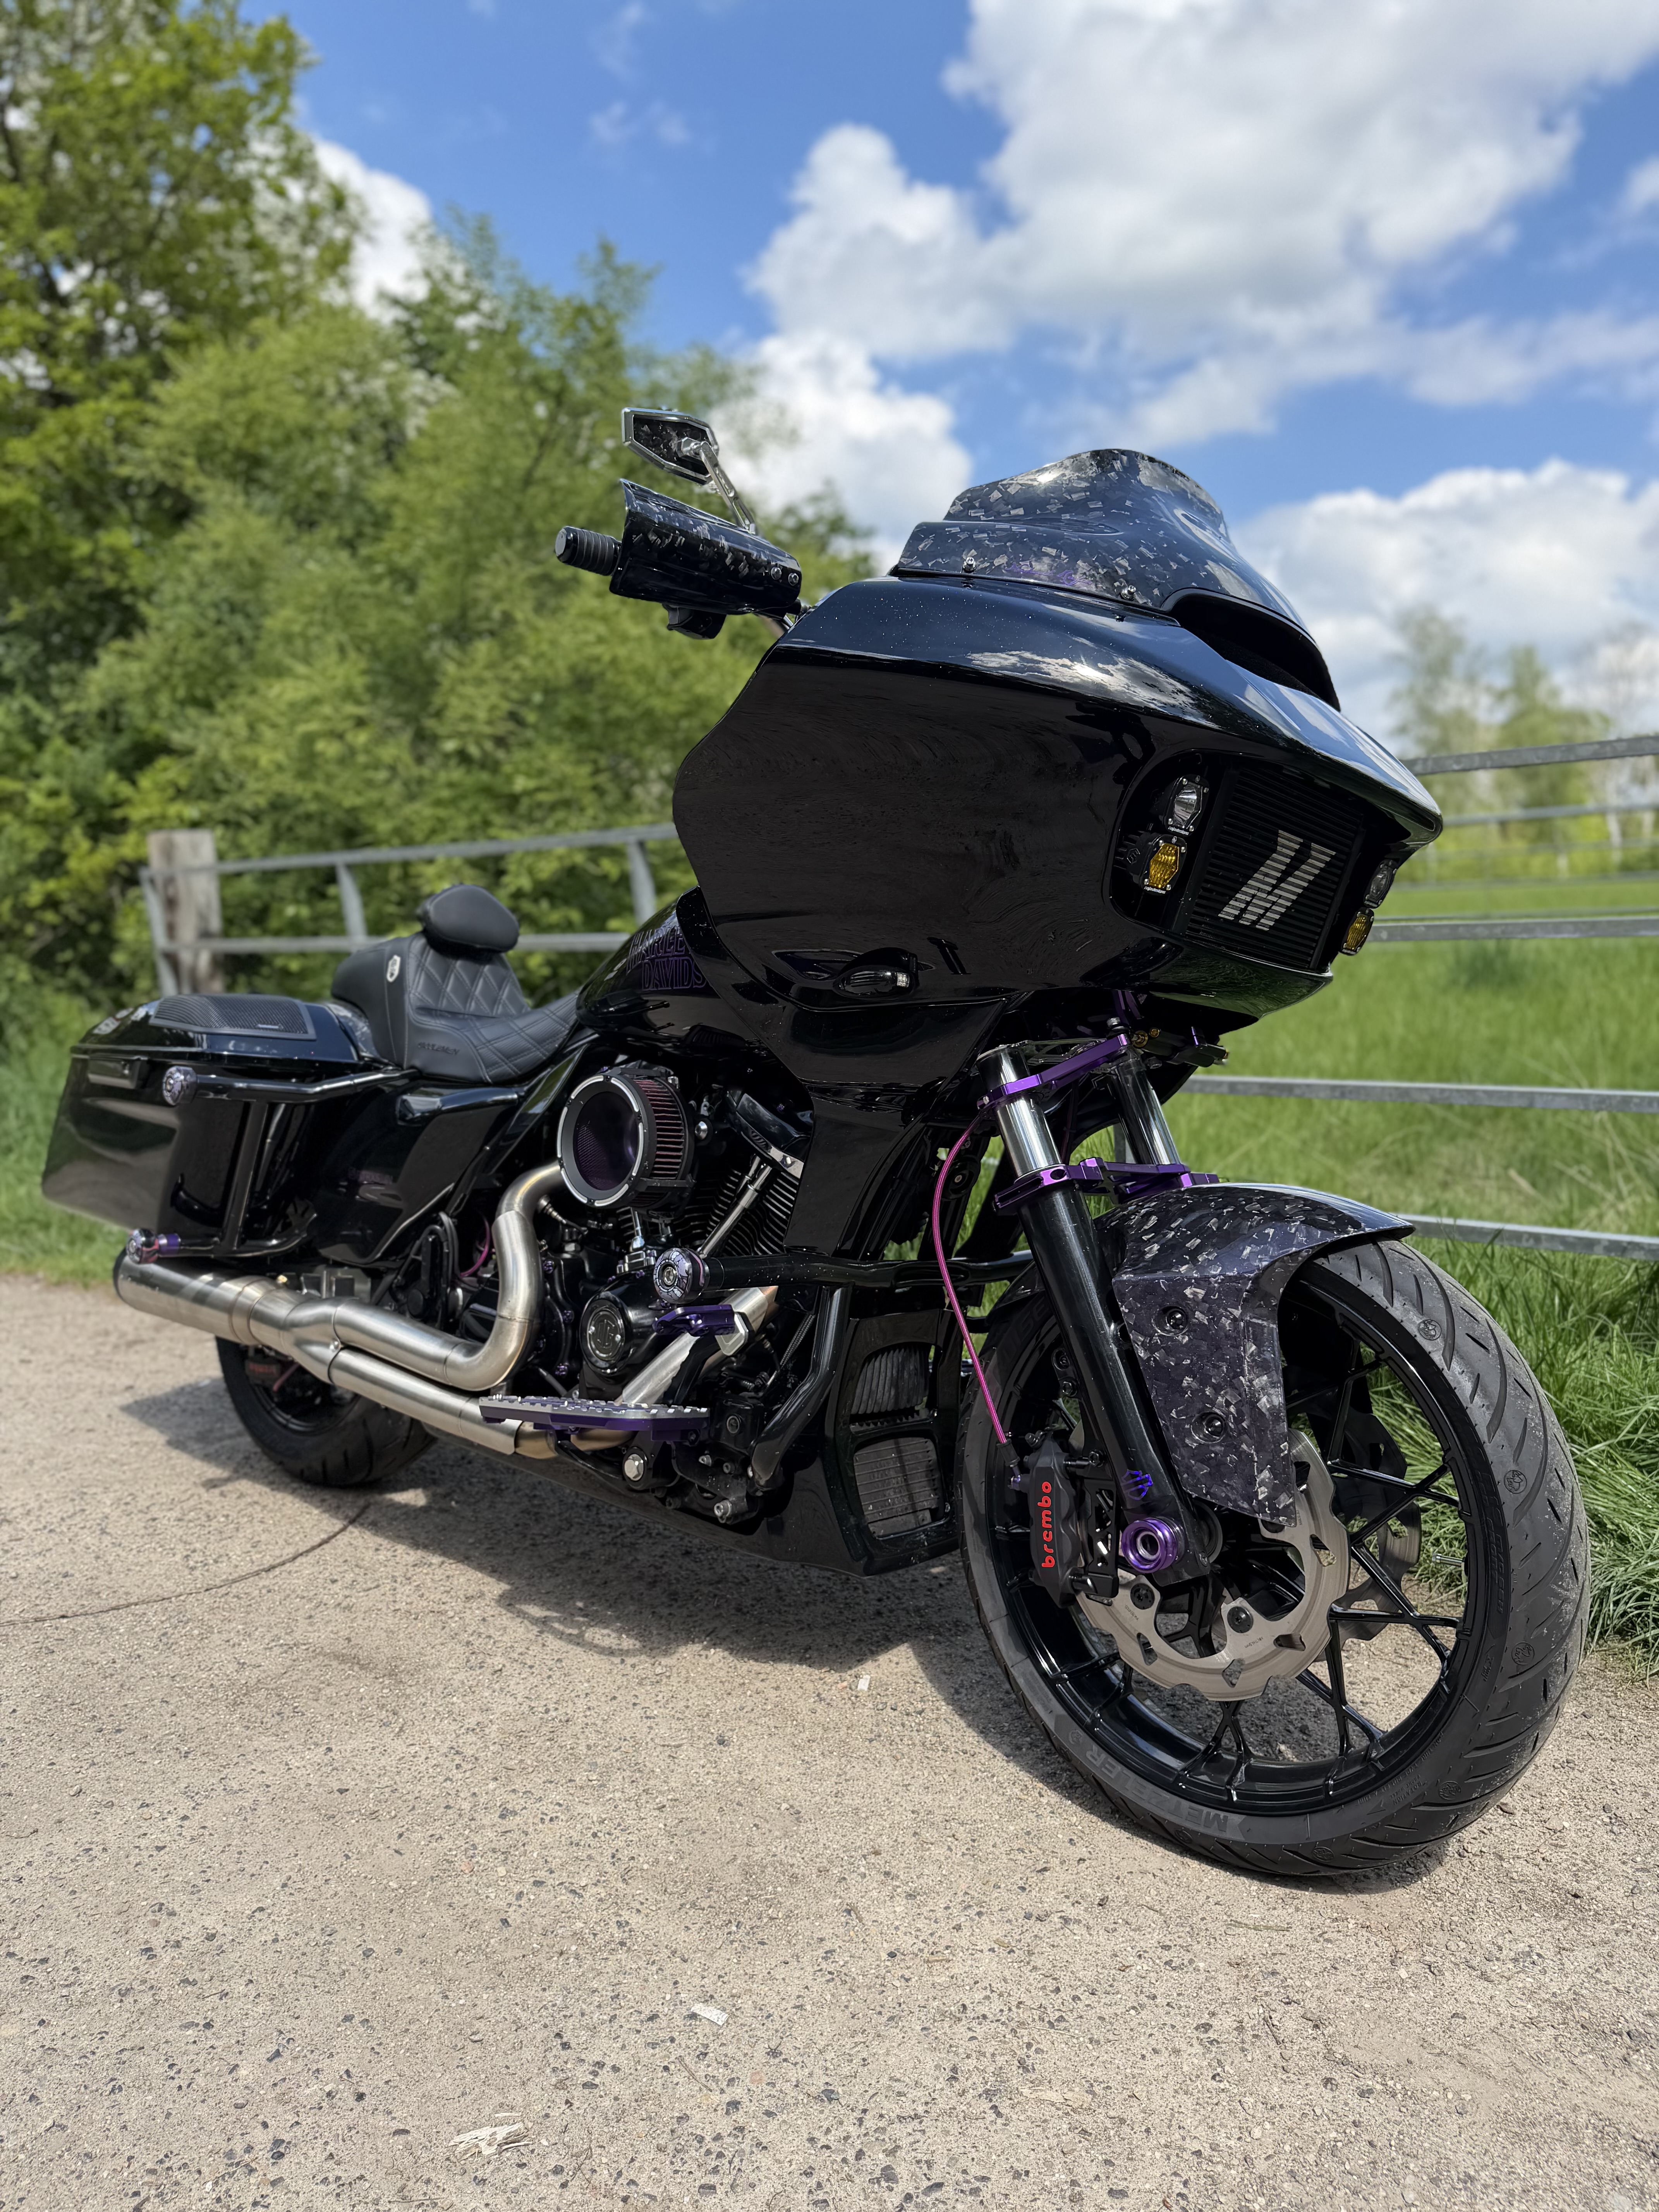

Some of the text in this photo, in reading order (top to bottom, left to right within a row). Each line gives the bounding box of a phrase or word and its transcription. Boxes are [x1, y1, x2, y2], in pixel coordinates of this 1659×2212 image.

[625, 924, 687, 976] HARLE
[641, 956, 707, 991] DAVIDS
[1037, 1481, 1055, 1568] brembo
[1086, 1745, 1229, 1832] METZELER
[1393, 1781, 1423, 1806] ROTATION
